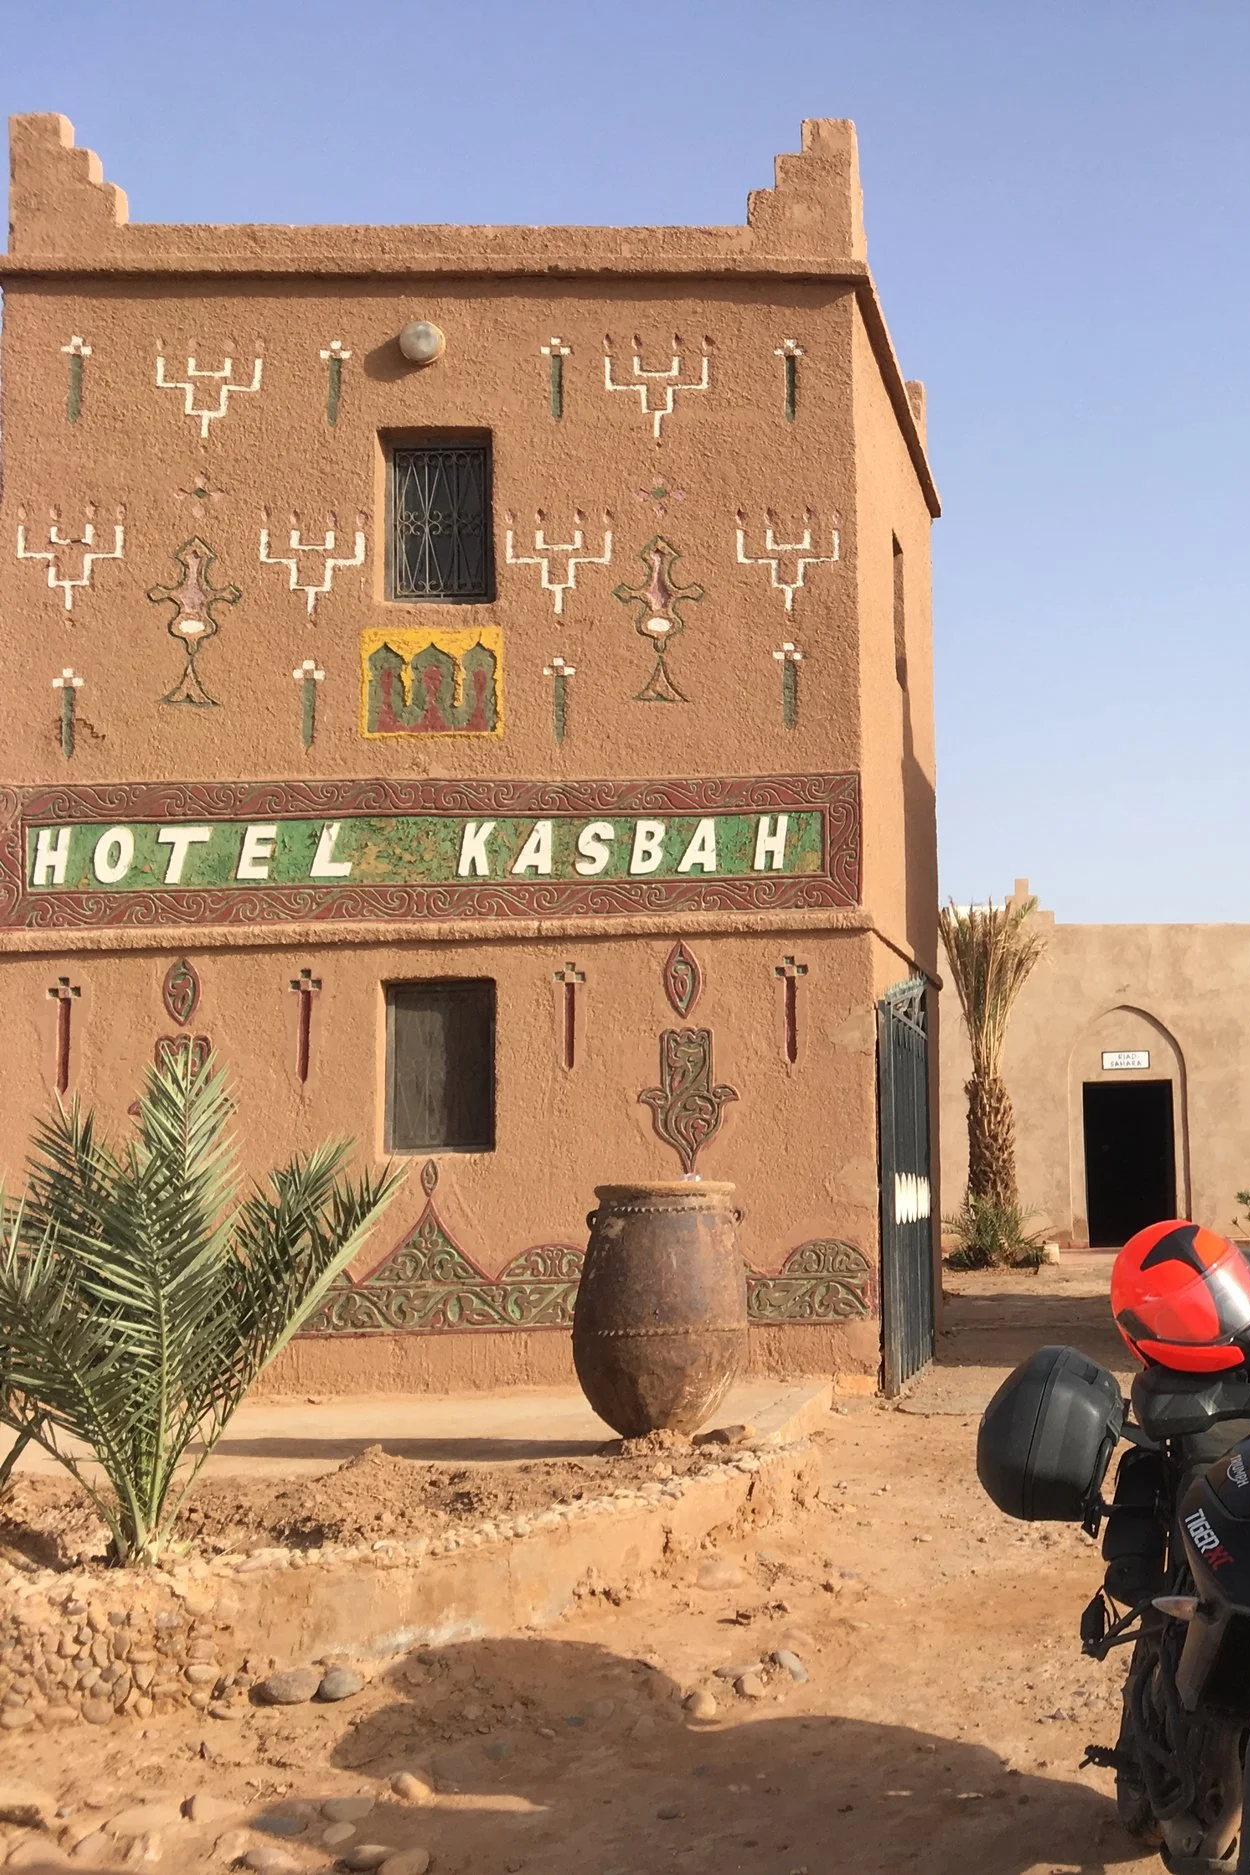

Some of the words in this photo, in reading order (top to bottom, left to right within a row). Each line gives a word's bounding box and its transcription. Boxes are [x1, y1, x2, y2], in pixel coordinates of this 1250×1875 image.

[33, 822, 353, 885] HOTEL
[457, 815, 789, 877] KASBAH
[1227, 1454, 1250, 1488] TRIUMPH
